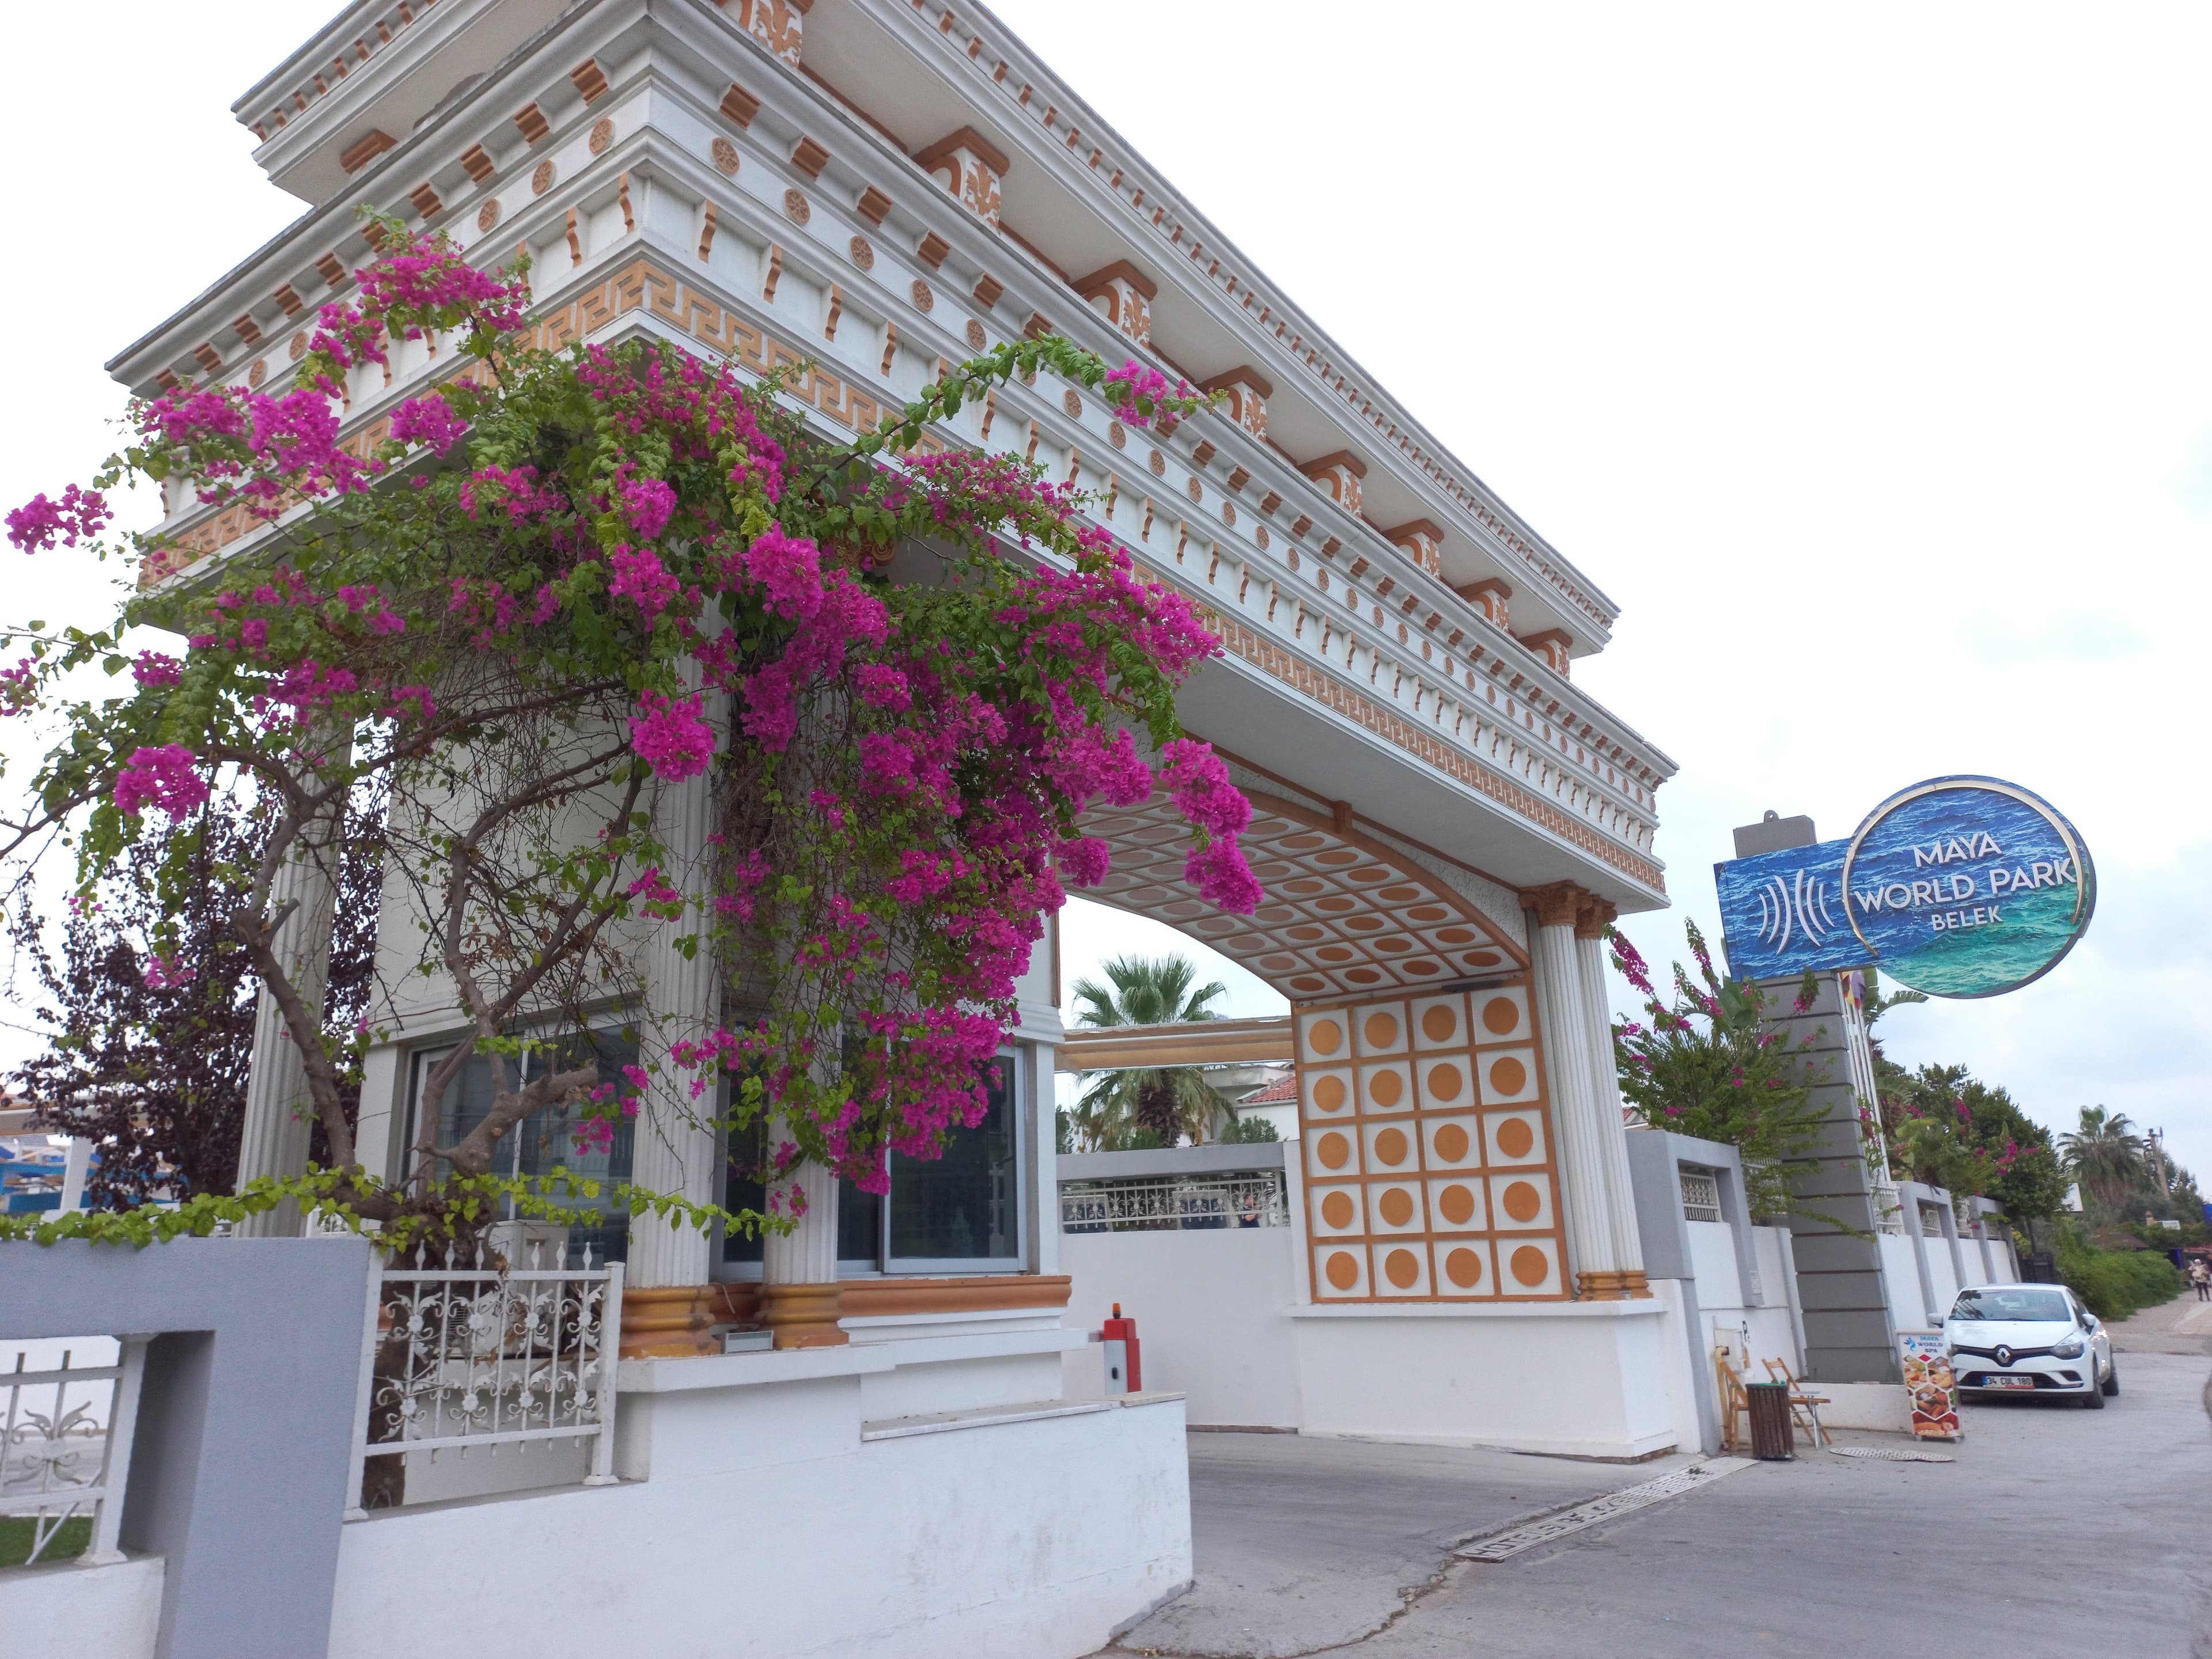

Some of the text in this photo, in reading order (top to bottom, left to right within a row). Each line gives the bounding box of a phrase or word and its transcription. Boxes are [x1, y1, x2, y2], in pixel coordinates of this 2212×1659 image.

[1913, 831, 2003, 868] MAYA
[1854, 857, 2077, 914] WORLD PARK
[1931, 904, 2003, 931] BELEK
